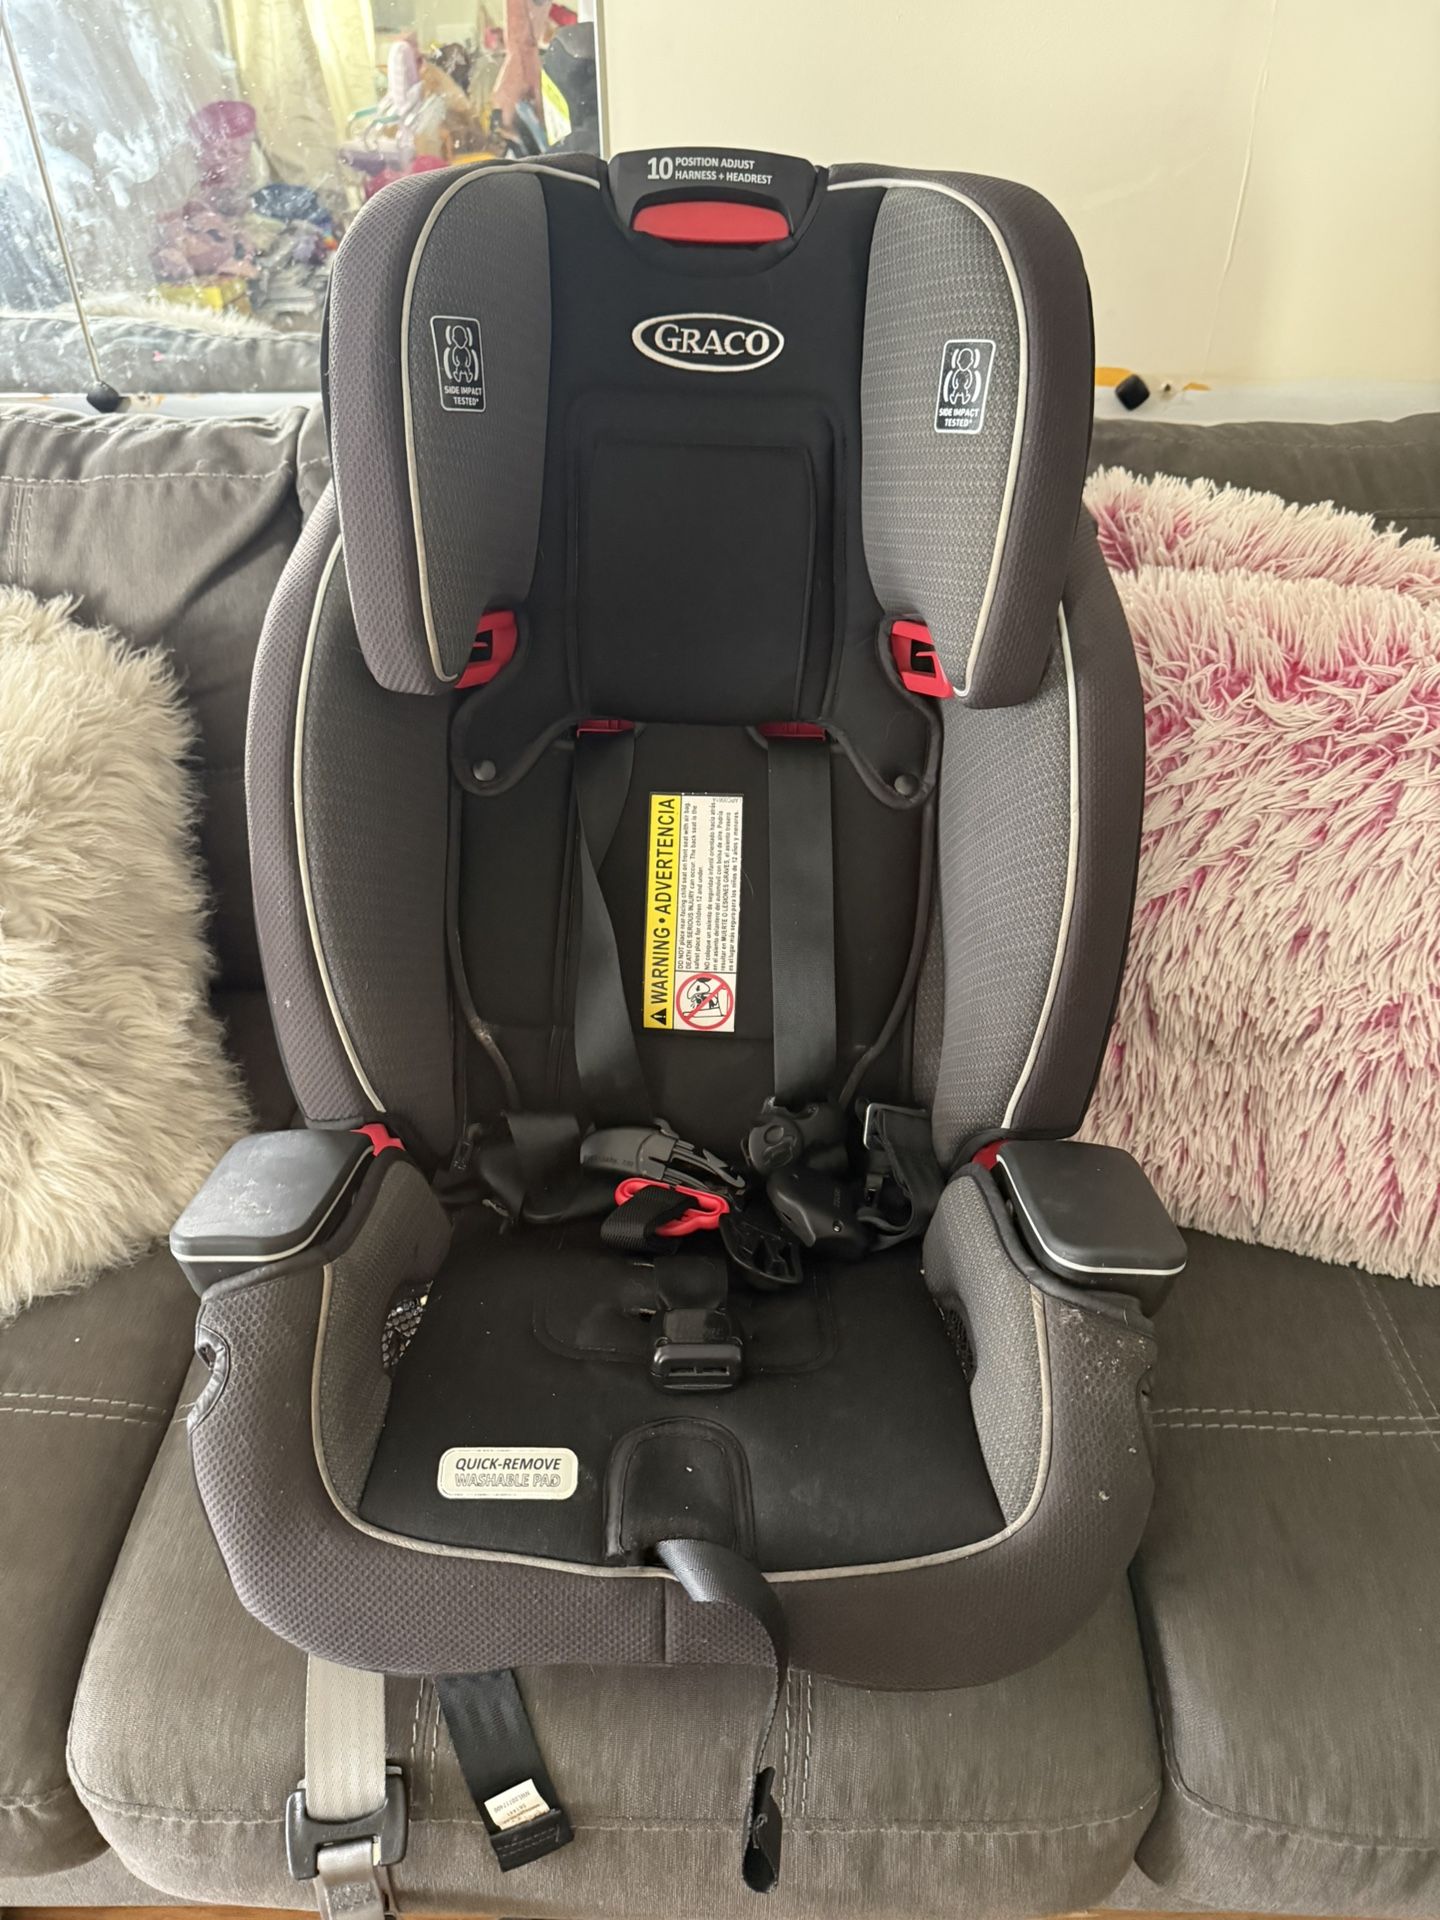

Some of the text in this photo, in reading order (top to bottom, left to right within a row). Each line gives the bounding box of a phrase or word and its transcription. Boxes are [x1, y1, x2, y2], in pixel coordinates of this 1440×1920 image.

[647, 156, 673, 180] 10
[676, 157, 755, 170] POSITION ADJUST
[675, 170, 717, 181] HARNESS
[726, 173, 773, 184] HEADREST
[654, 323, 770, 355] GRACO
[444, 385, 482, 396] SIDE IMPACT
[939, 408, 980, 416] SIDE IMPACT
[654, 799, 675, 915] ADVERTENCIA
[650, 927, 671, 1004] WARNING
[456, 1458, 562, 1470] QUICK-REMOVE
[455, 1473, 561, 1487] WASHABLE PAD
